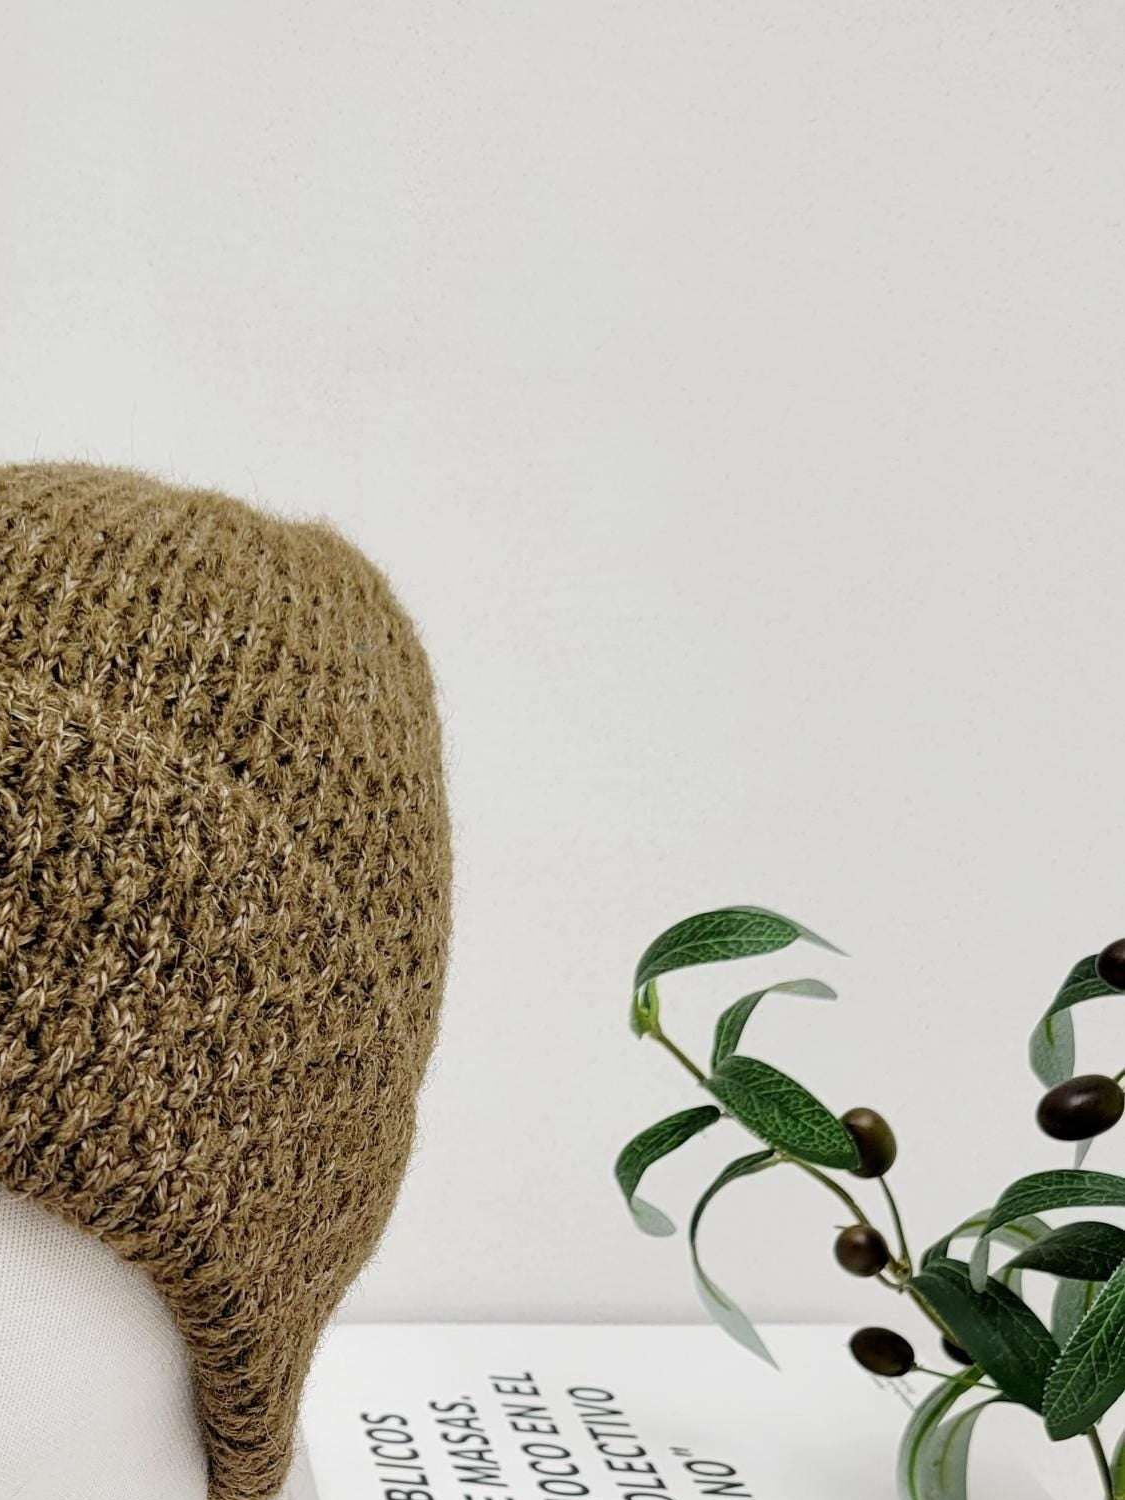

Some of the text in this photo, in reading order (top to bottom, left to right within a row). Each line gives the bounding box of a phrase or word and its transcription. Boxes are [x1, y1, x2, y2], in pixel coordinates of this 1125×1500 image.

[488, 1371, 540, 1396] EL
[501, 1403, 560, 1435] EN
[429, 1395, 508, 1487] MASAS.
